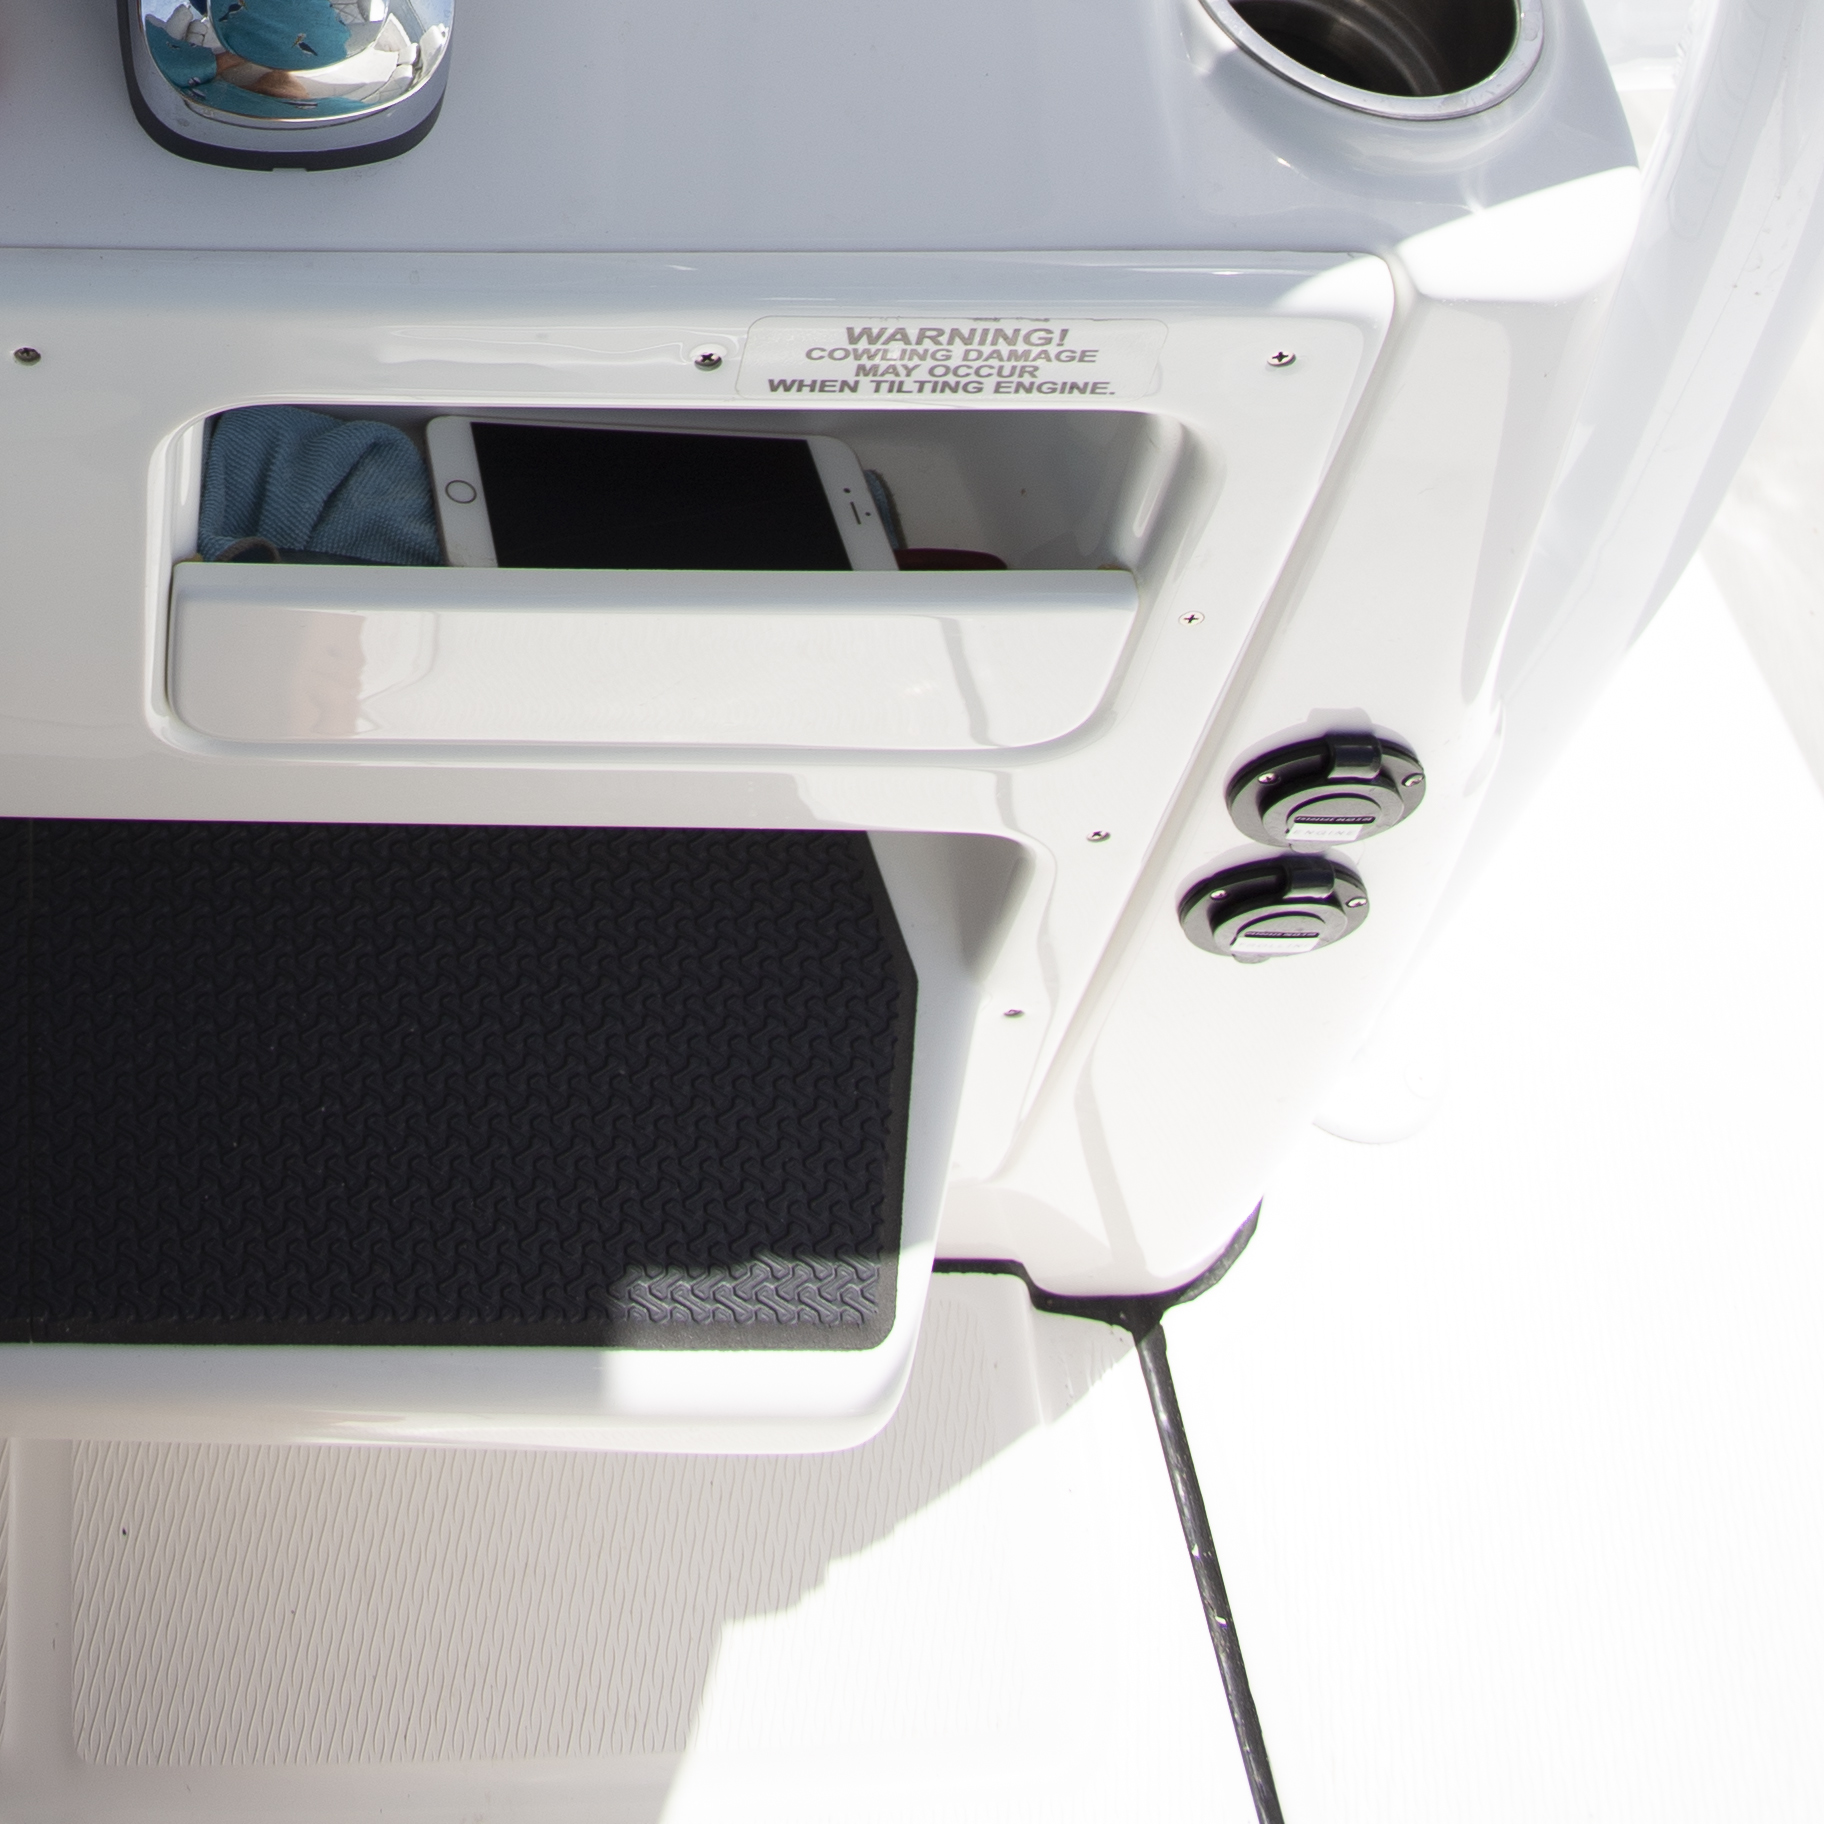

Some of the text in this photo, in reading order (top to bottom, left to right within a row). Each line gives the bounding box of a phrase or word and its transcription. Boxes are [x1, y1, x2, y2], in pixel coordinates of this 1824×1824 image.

[845, 326, 1069, 347] WARNING!
[805, 347, 1099, 364] COWLING DAMAGE
[854, 363, 1040, 379] MAY OCCUR
[767, 379, 1116, 396] WHEN TILTING ENGINE.
